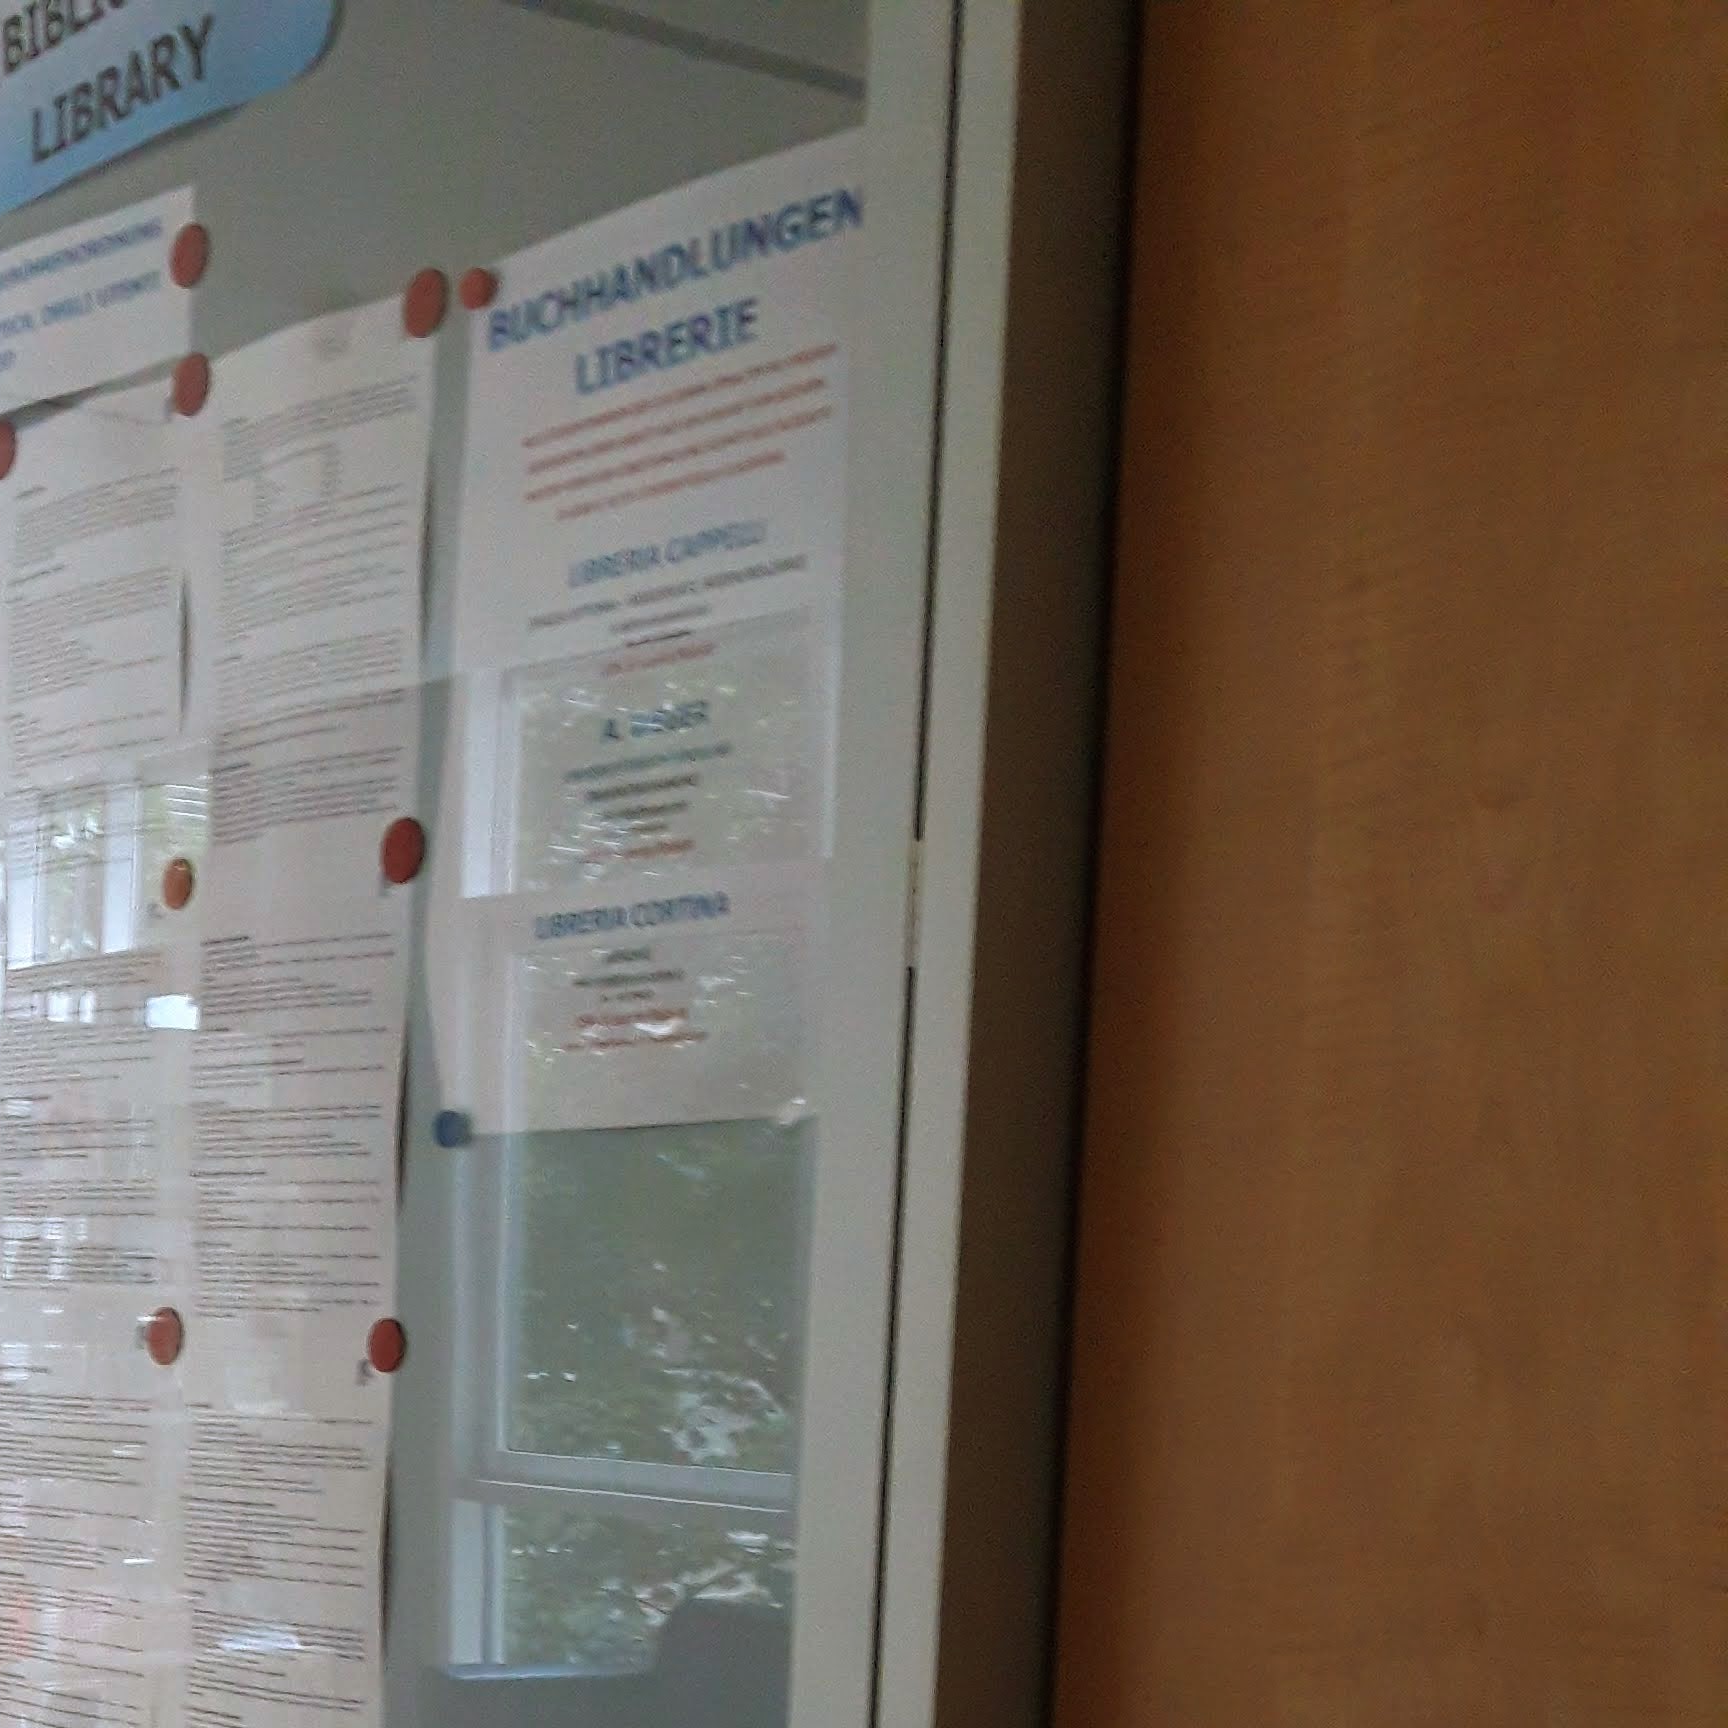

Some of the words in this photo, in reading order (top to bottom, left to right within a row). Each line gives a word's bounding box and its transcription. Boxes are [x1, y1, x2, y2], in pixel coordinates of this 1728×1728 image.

[30, 12, 215, 163] LIBRARY
[487, 185, 865, 352] BUCHHANDLUNGEN
[574, 297, 760, 394] LIBRERIE
